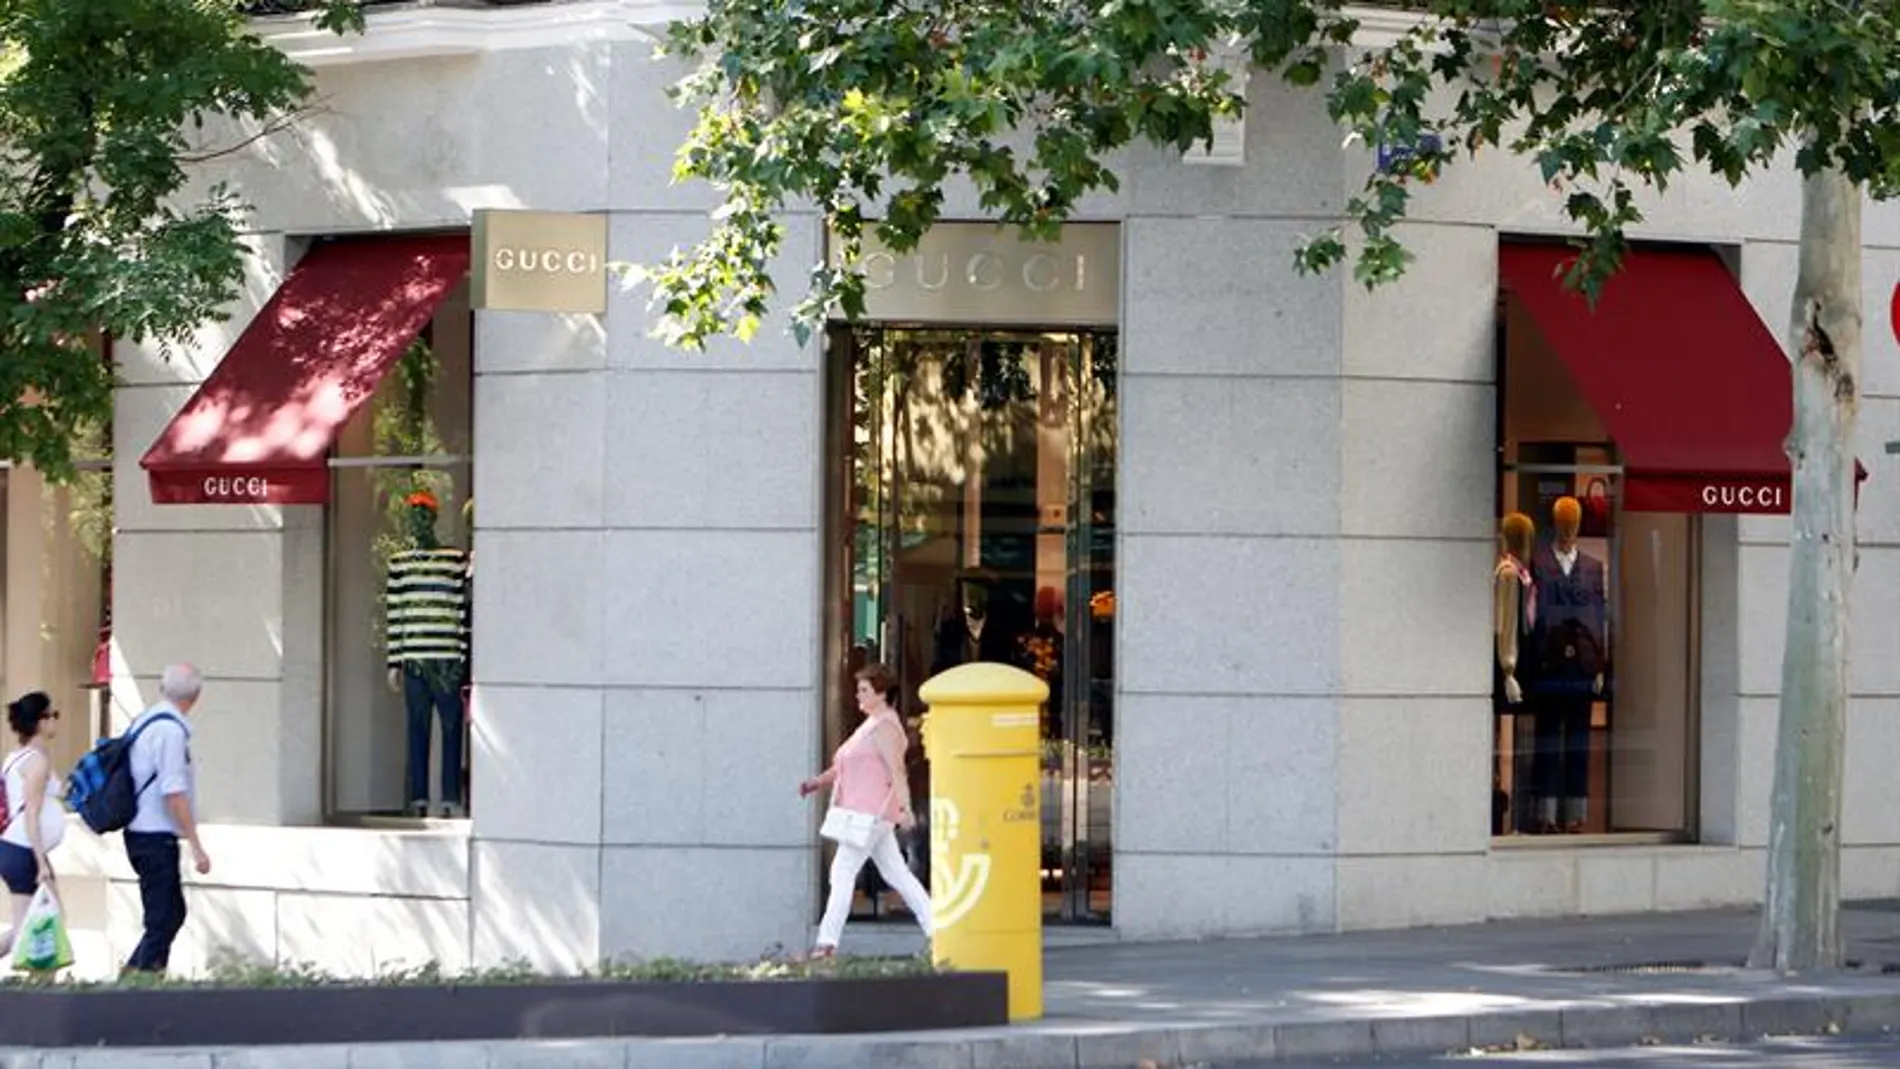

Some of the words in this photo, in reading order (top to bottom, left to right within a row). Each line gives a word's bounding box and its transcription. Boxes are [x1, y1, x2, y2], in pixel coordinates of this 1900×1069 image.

[494, 248, 597, 274] GUCCI
[863, 251, 1085, 292] GUCCI
[203, 476, 268, 497] GUCCI
[1702, 485, 1781, 507] GUCCI
